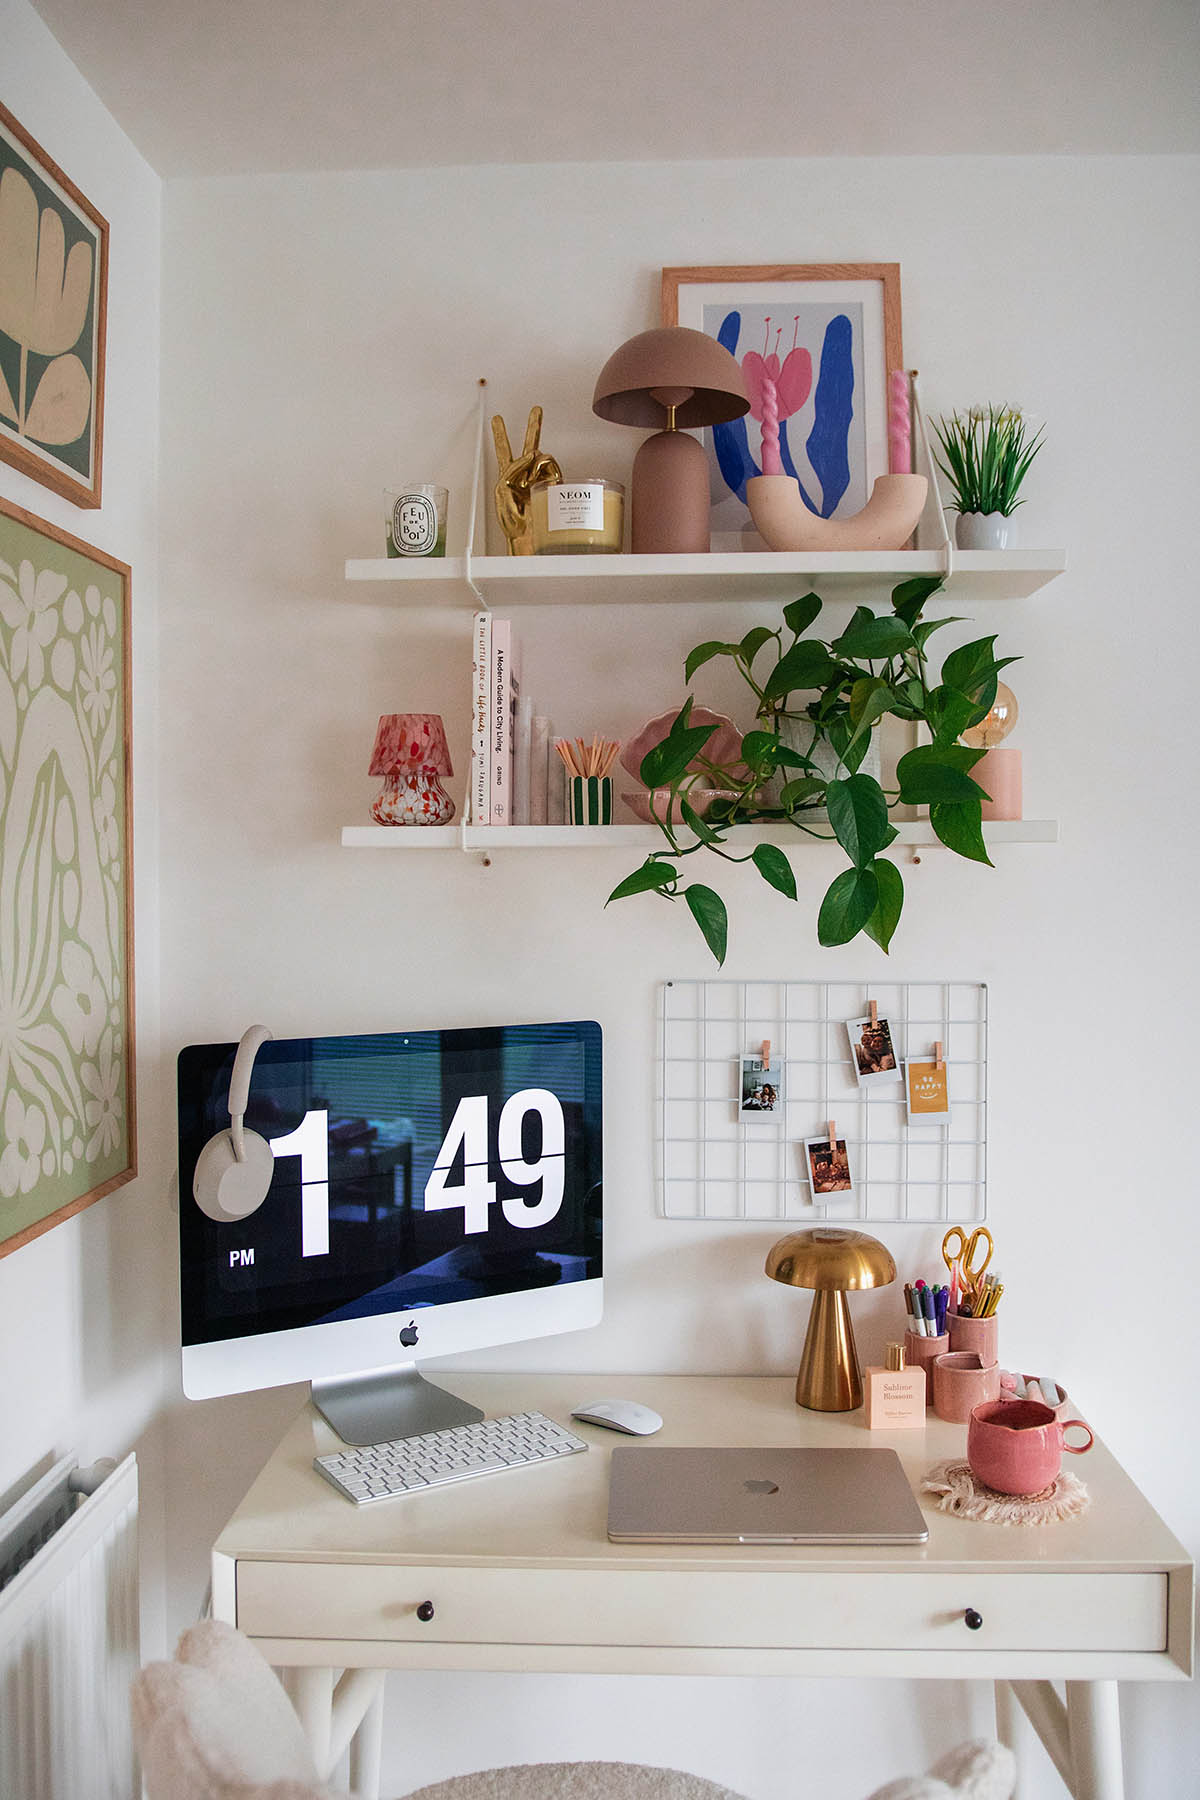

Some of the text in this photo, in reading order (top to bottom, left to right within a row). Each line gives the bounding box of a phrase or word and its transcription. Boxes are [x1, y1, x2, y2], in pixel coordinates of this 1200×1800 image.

[559, 491, 591, 499] NEOM
[403, 507, 425, 521] FEU
[479, 665, 487, 680] BOOK
[476, 695, 487, 708] Life
[496, 684, 504, 705] Guide
[496, 706, 504, 714] to
[495, 716, 504, 729] City
[495, 732, 504, 754] Living.
[269, 1087, 566, 1258] 1 49
[229, 1248, 255, 1268] PM
[883, 1383, 913, 1391] Sublime
